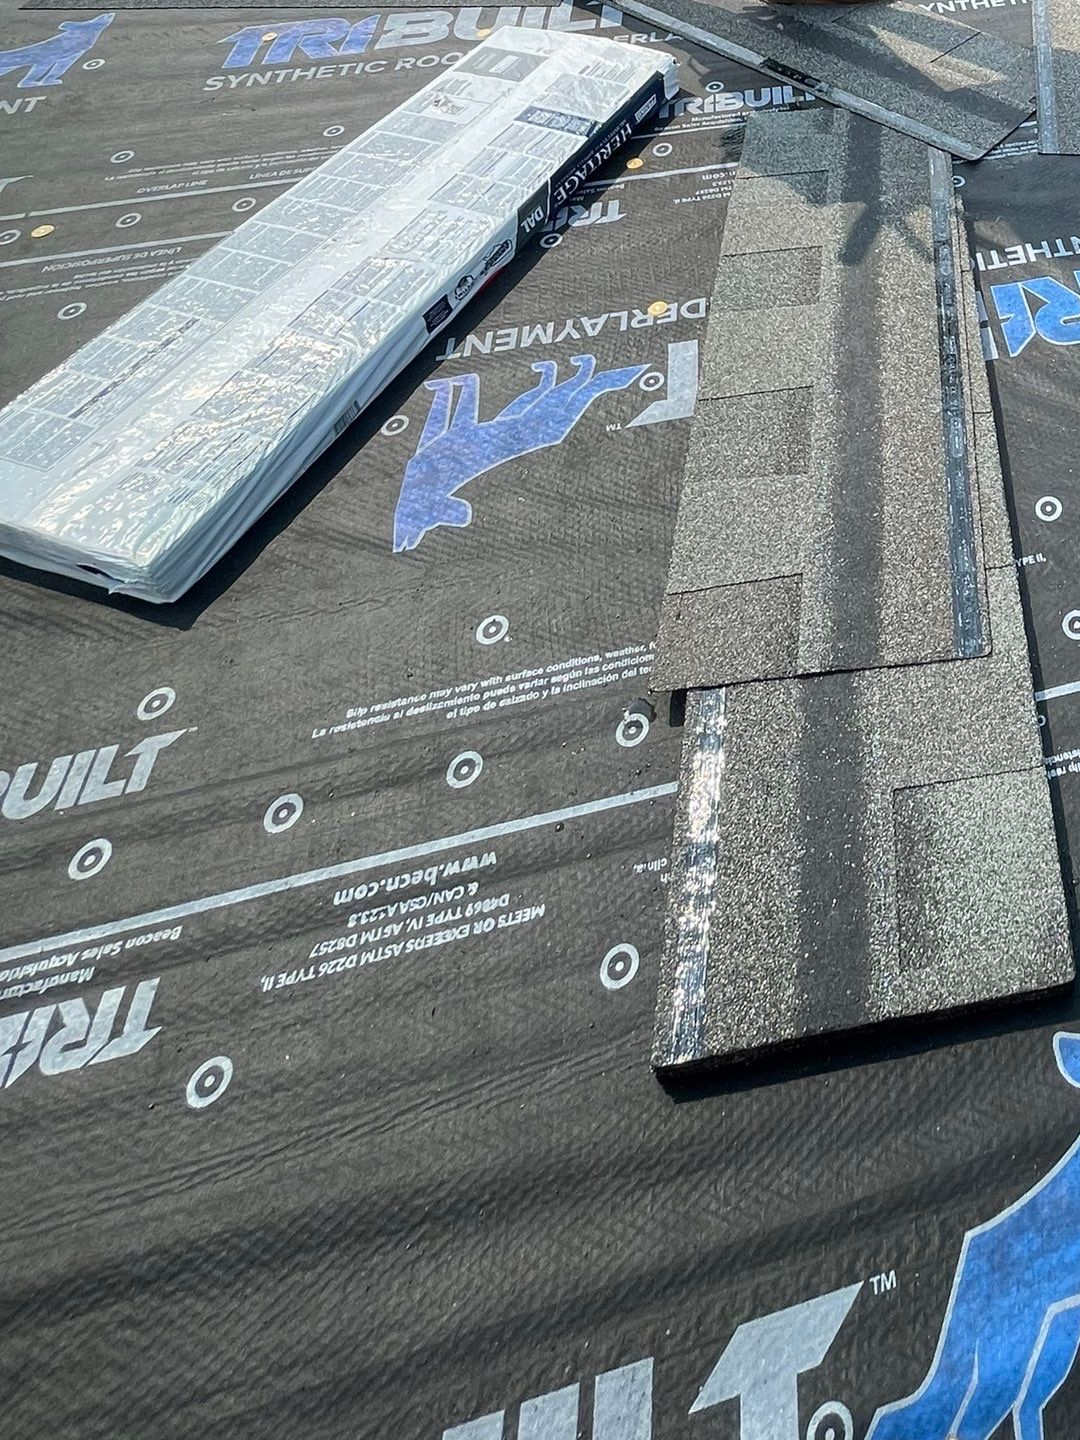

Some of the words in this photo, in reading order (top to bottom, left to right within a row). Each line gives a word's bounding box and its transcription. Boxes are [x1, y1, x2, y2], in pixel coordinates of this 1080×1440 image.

[202, 59, 387, 91] SYNTHETIC
[553, 122, 632, 208] HERITAGE
[429, 687, 453, 701] may
[455, 682, 478, 696] vary
[481, 675, 502, 688] with
[506, 667, 543, 682] surface
[546, 654, 603, 674] conditions,
[605, 643, 647, 660] weather,
[542, 688, 549, 700] y
[622, 667, 637, 679] del
[312, 728, 326, 739] La
[585, 664, 600, 676] las
[602, 652, 655, 672] condicion
[333, 852, 497, 906] www.becn.com
[467, 881, 479, 896] &
[400, 886, 465, 910] CAN/CSA
[464, 894, 510, 918] D4869
[406, 915, 424, 931] IV,
[426, 906, 463, 925] TYPE
[474, 916, 495, 935] OR
[498, 904, 546, 928] MEETS
[125, 925, 183, 950] Beacon
[360, 921, 403, 944] ASTM
[405, 923, 470, 953] EXCEEDS
[80, 940, 124, 960] Sales
[309, 934, 358, 958] D8257
[360, 940, 403, 965] ASTM
[0, 951, 80, 981] Acquisitio
[277, 965, 317, 985] TYPE
[319, 953, 358, 974] D226
[870, 1269, 897, 1295] TM
